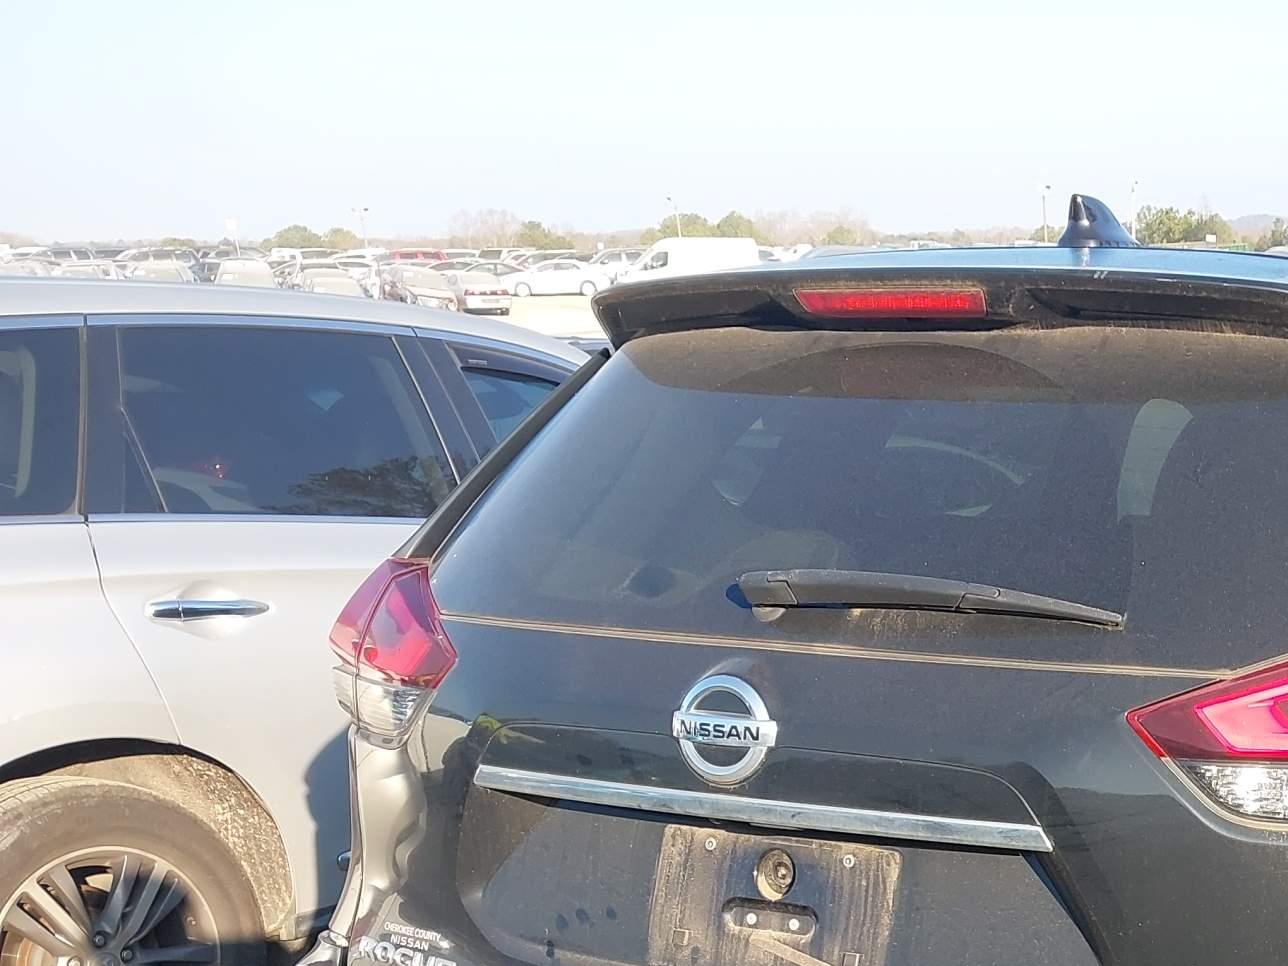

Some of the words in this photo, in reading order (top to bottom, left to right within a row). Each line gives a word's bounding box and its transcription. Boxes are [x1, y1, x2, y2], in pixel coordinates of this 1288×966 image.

[679, 719, 760, 742] NISSAN
[390, 933, 430, 951] NISSAN
[414, 927, 442, 943] COUNTY
